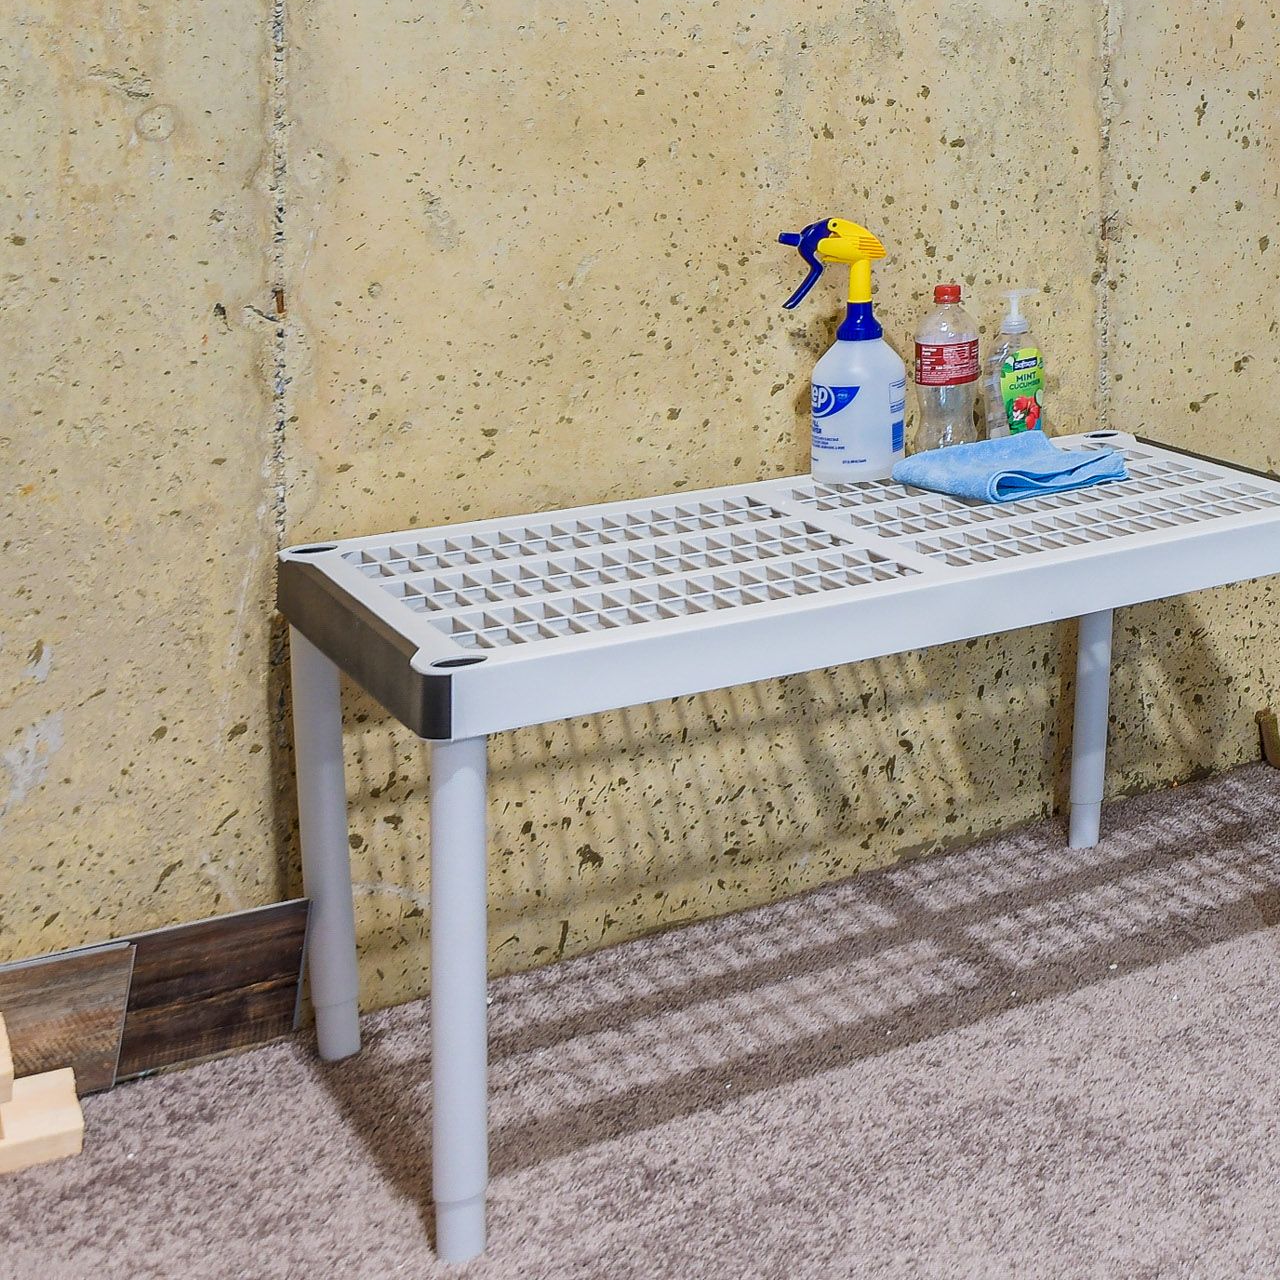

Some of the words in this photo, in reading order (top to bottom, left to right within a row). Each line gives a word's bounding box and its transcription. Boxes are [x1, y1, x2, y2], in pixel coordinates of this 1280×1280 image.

[1016, 372, 1036, 382] MINT
[1009, 379, 1040, 390] CUCUMBER
[812, 387, 828, 408] ep
